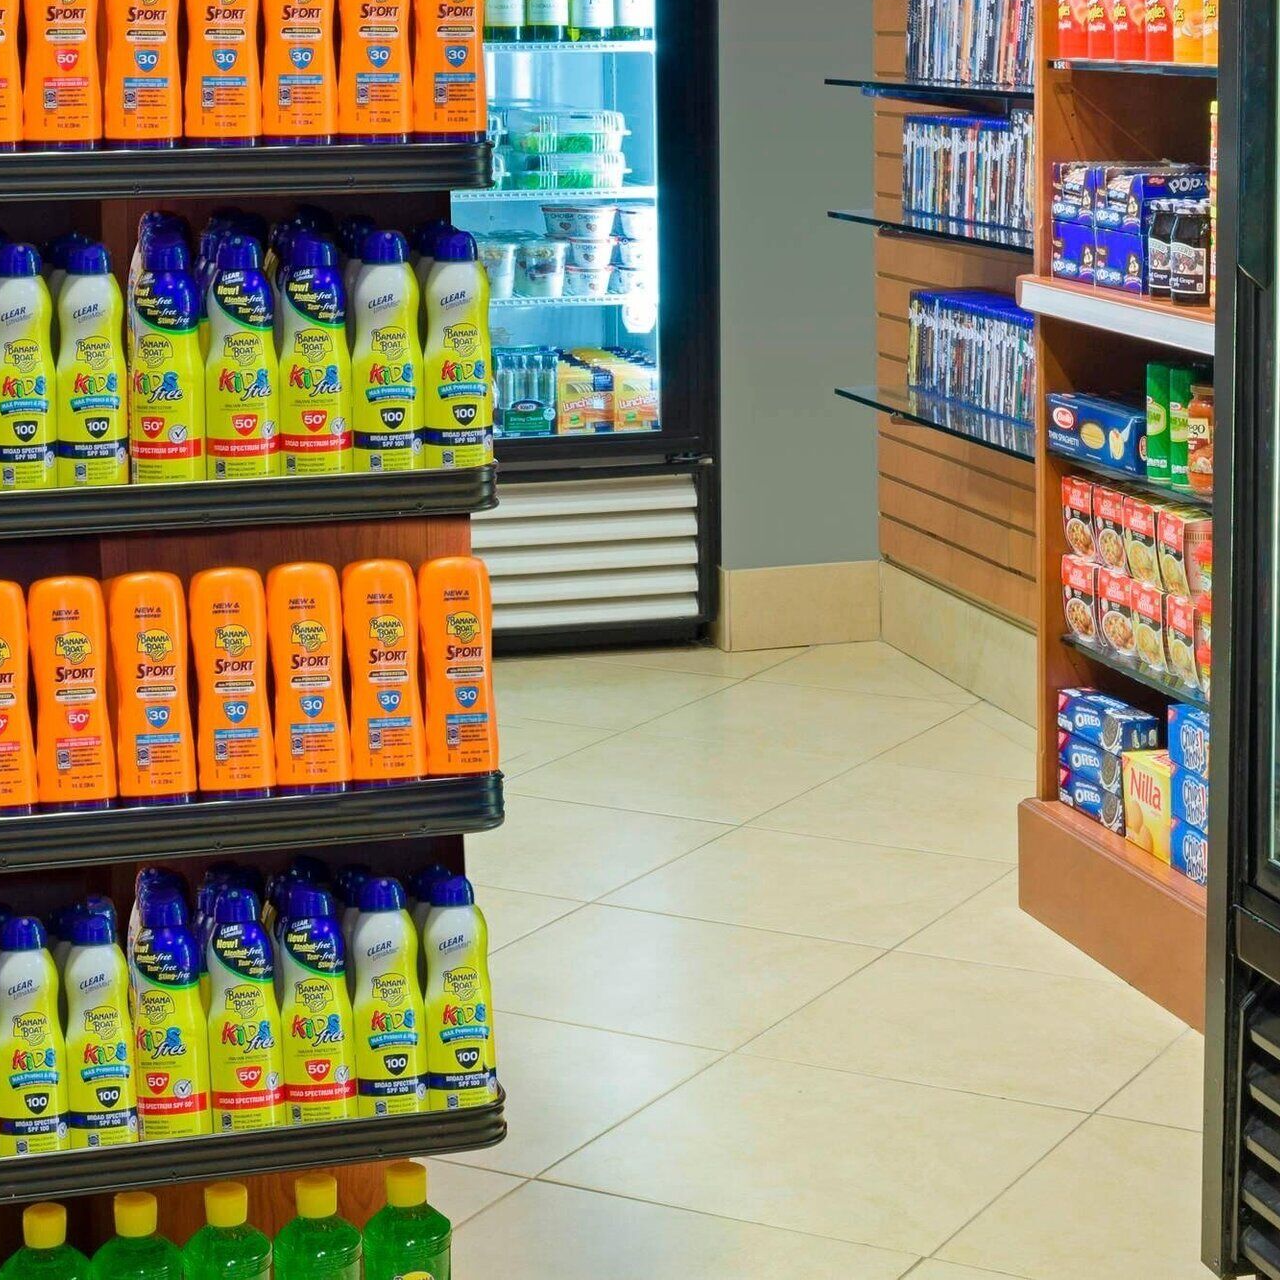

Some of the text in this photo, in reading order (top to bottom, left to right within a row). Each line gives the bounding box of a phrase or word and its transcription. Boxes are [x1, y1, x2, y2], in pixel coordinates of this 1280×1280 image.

[46, 7, 86, 22] SPORT
[127, 7, 167, 22] SPORT
[205, 8, 246, 22] SPORT
[282, 6, 321, 21] SPORT
[360, 4, 399, 19] SPORT
[438, 5, 474, 19] SPORT
[138, 54, 157, 64] 30
[216, 53, 235, 64] 30
[292, 51, 311, 62] 30
[369, 50, 389, 60] 30
[448, 50, 466, 60] 30
[440, 290, 466, 306] CLEAR
[0, 306, 26, 322] CLEAR
[224, 336, 259, 347] BANANA
[232, 345, 254, 356] BOAT
[454, 408, 475, 418] 100
[14, 424, 36, 435] 100
[369, 649, 407, 663] SPORT
[446, 645, 483, 660] SPORT
[214, 659, 254, 674] SPORT
[291, 654, 330, 669] SPORT
[55, 667, 95, 682] SPORT
[136, 664, 175, 679] SPORT
[380, 695, 399, 705] 30
[458, 690, 477, 701] 30
[227, 705, 246, 716] 30
[303, 700, 322, 710] 30
[149, 710, 168, 720] 30
[1075, 713, 1100, 727] OREO
[1072, 753, 1100, 768] OREO
[1075, 789, 1100, 803] OREO
[1130, 767, 1162, 811] Nilla
[366, 939, 393, 958] CLEAR
[385, 1058, 407, 1068] 100
